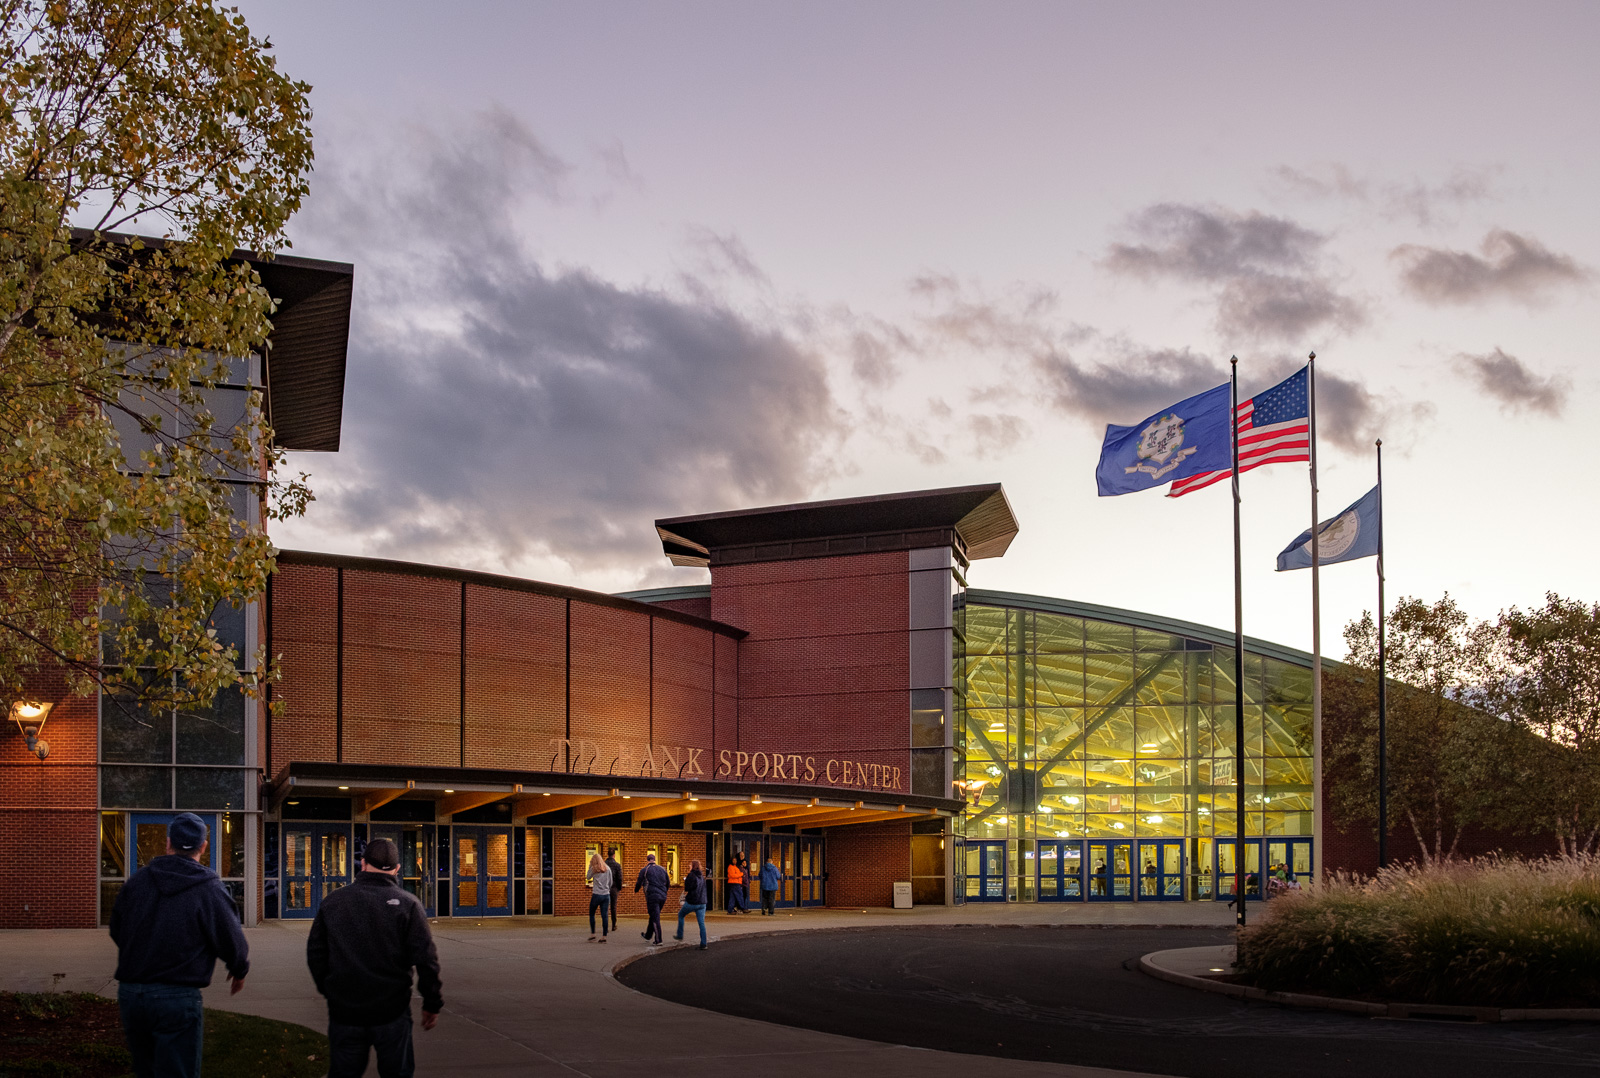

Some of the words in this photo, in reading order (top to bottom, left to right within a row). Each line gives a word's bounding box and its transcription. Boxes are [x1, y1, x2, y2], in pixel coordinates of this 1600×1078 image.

[550, 739, 601, 772] TD
[719, 749, 816, 782] SPORTS
[826, 759, 902, 790] CENTER
